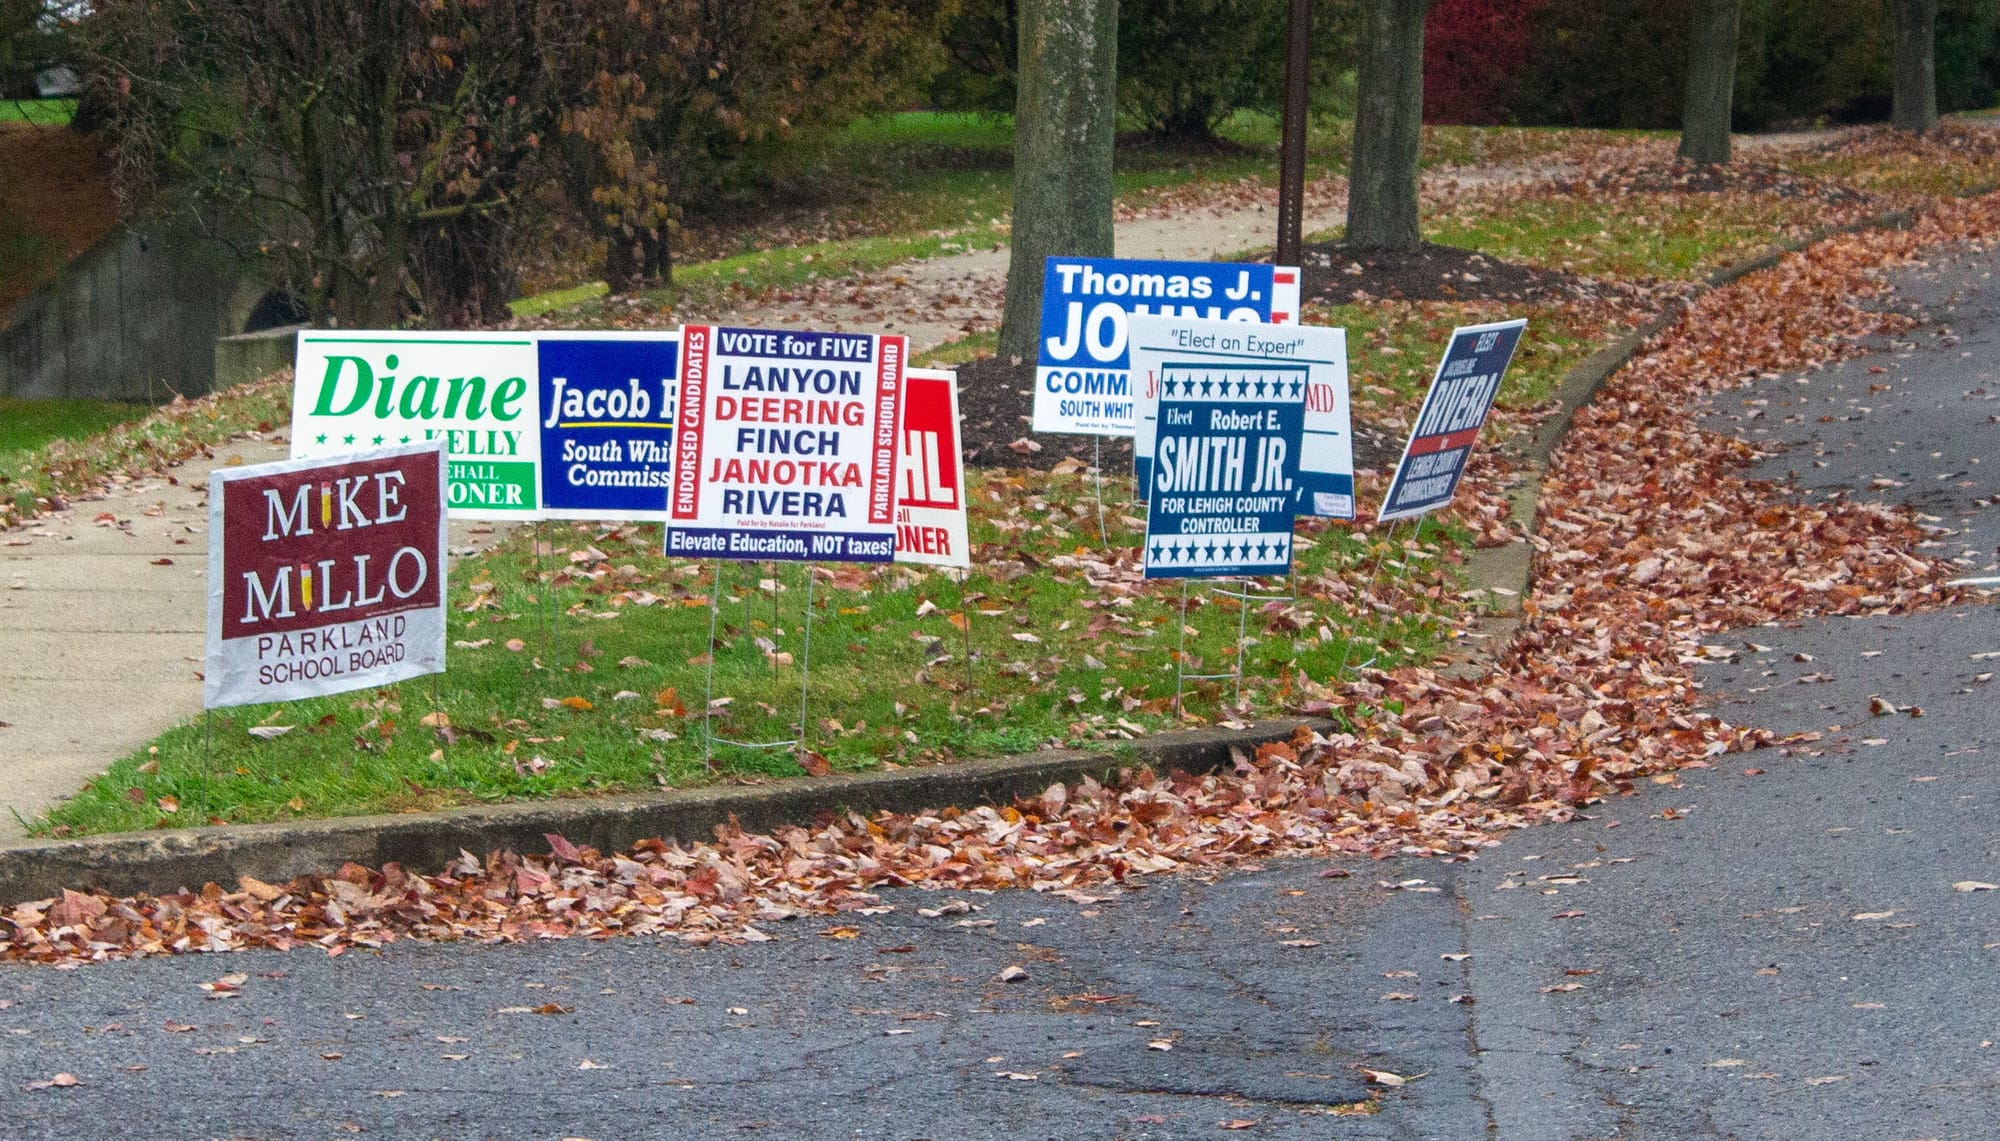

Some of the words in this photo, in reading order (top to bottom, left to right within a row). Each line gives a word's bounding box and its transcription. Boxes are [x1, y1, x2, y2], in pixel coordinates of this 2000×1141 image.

[1056, 264, 1213, 299] Thomas
[1225, 271, 1261, 300] J.
[721, 332, 777, 355] VOTE
[783, 335, 815, 356] for
[821, 338, 868, 359] FIVE
[1221, 338, 1240, 350] an
[683, 332, 706, 428] CANDIDATES
[722, 365, 861, 395] LANYON
[881, 343, 898, 390] BOARD
[309, 354, 527, 421] Diane
[544, 377, 651, 429] Jacob
[715, 396, 865, 426] DEERING
[1060, 399, 1100, 418] SOUTH
[1419, 372, 1498, 437] RIVERA
[877, 391, 896, 447] SCHOOL
[1167, 408, 1192, 425] Elect
[1210, 409, 1262, 430] Robert
[1267, 410, 1281, 430] E.
[562, 439, 622, 462] South
[736, 428, 839, 456] FINCH
[677, 431, 699, 514] ENDORSED
[708, 458, 863, 487] JANOTKA
[1157, 436, 1246, 492] SMITH
[1251, 437, 1292, 493] JR.
[873, 450, 893, 520] PARKLAND
[722, 489, 847, 518] RIVERA
[1161, 498, 1185, 514] FOR
[1188, 497, 1234, 513] LEHIGH
[1236, 496, 1285, 513] COUNTY
[1181, 517, 1260, 533] CONTROLLER
[671, 531, 726, 551] Elevate
[730, 533, 807, 557] Education,
[812, 536, 844, 554] NOT
[848, 538, 893, 556] taxes!
[258, 615, 406, 657] PARKLAND
[259, 655, 344, 686] SCHOOL
[349, 643, 405, 672] BOARD
